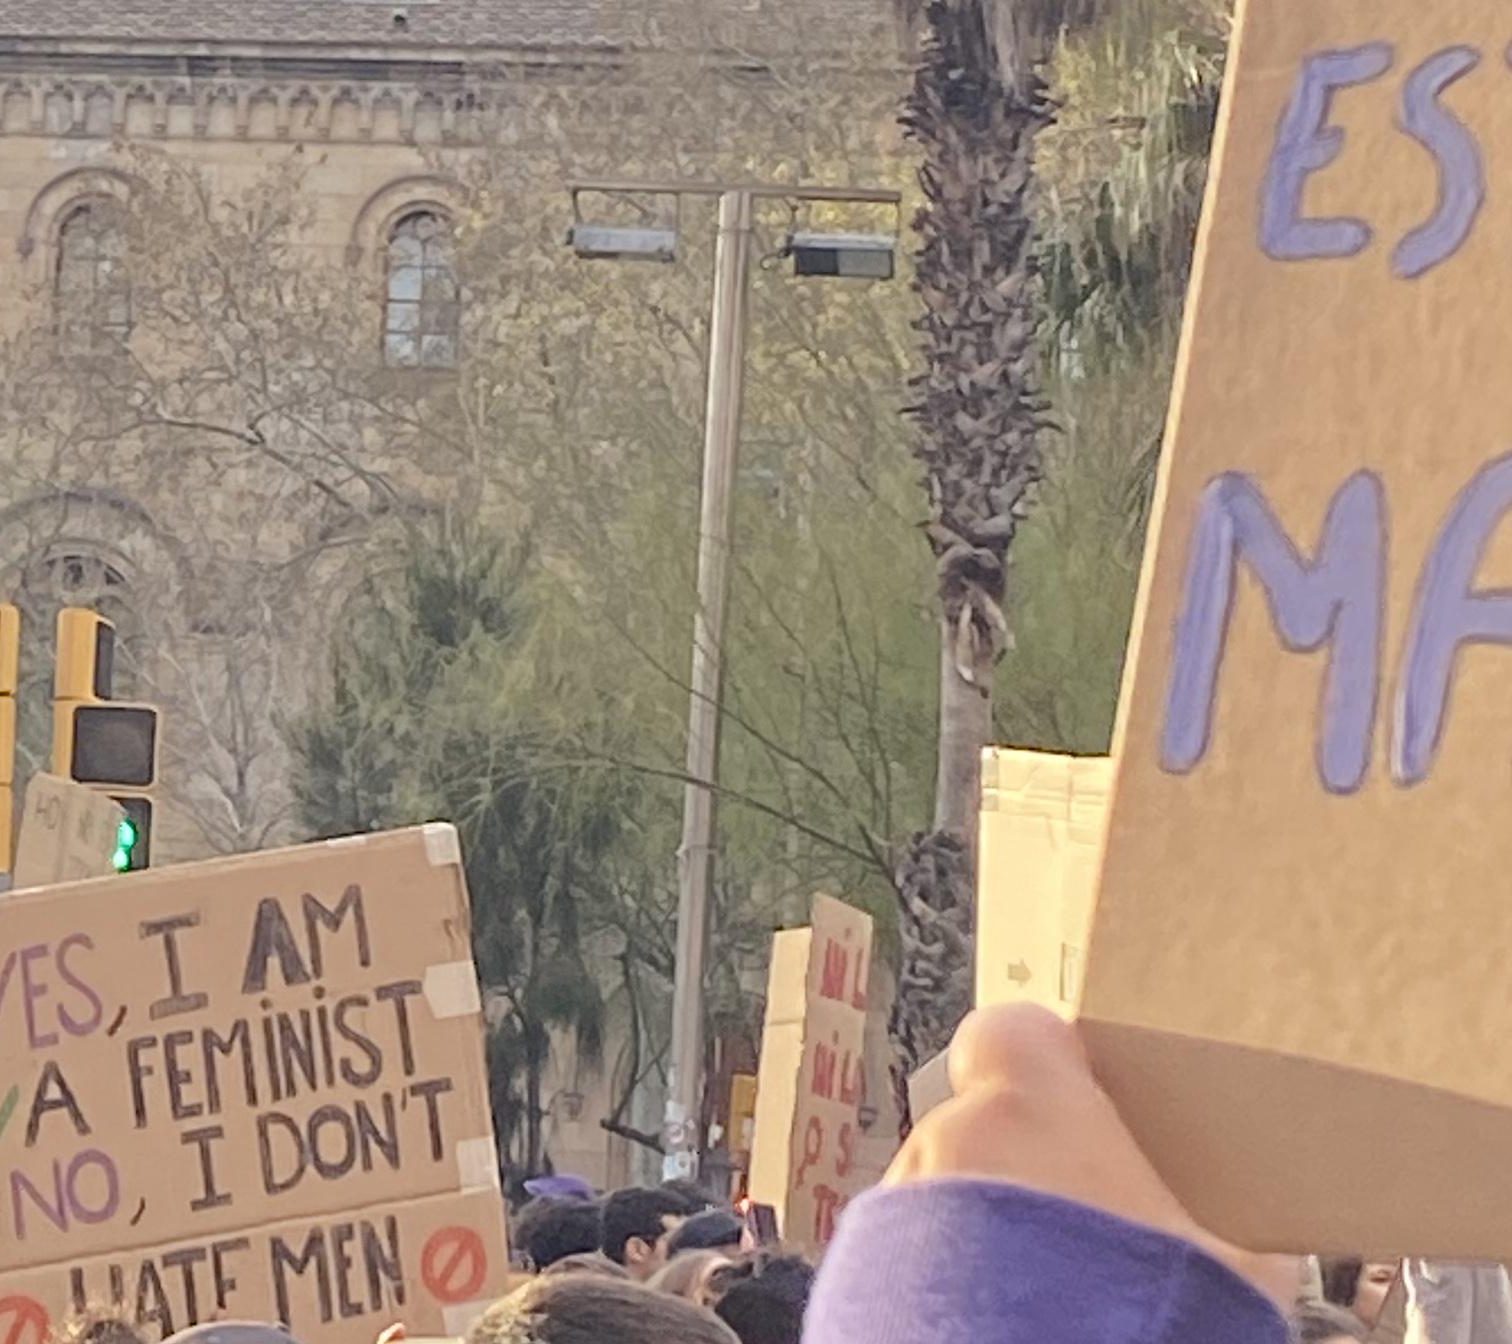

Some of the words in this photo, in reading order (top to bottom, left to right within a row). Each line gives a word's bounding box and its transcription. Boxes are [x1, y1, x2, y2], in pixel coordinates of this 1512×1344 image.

[138, 911, 208, 1021] I
[241, 884, 372, 994] AM
[10, 1148, 147, 1241] NO,
[180, 1124, 233, 1212] I
[256, 1077, 454, 1196] DON'T
[24, 1060, 92, 1147] A
[269, 1214, 407, 1328] MEN
